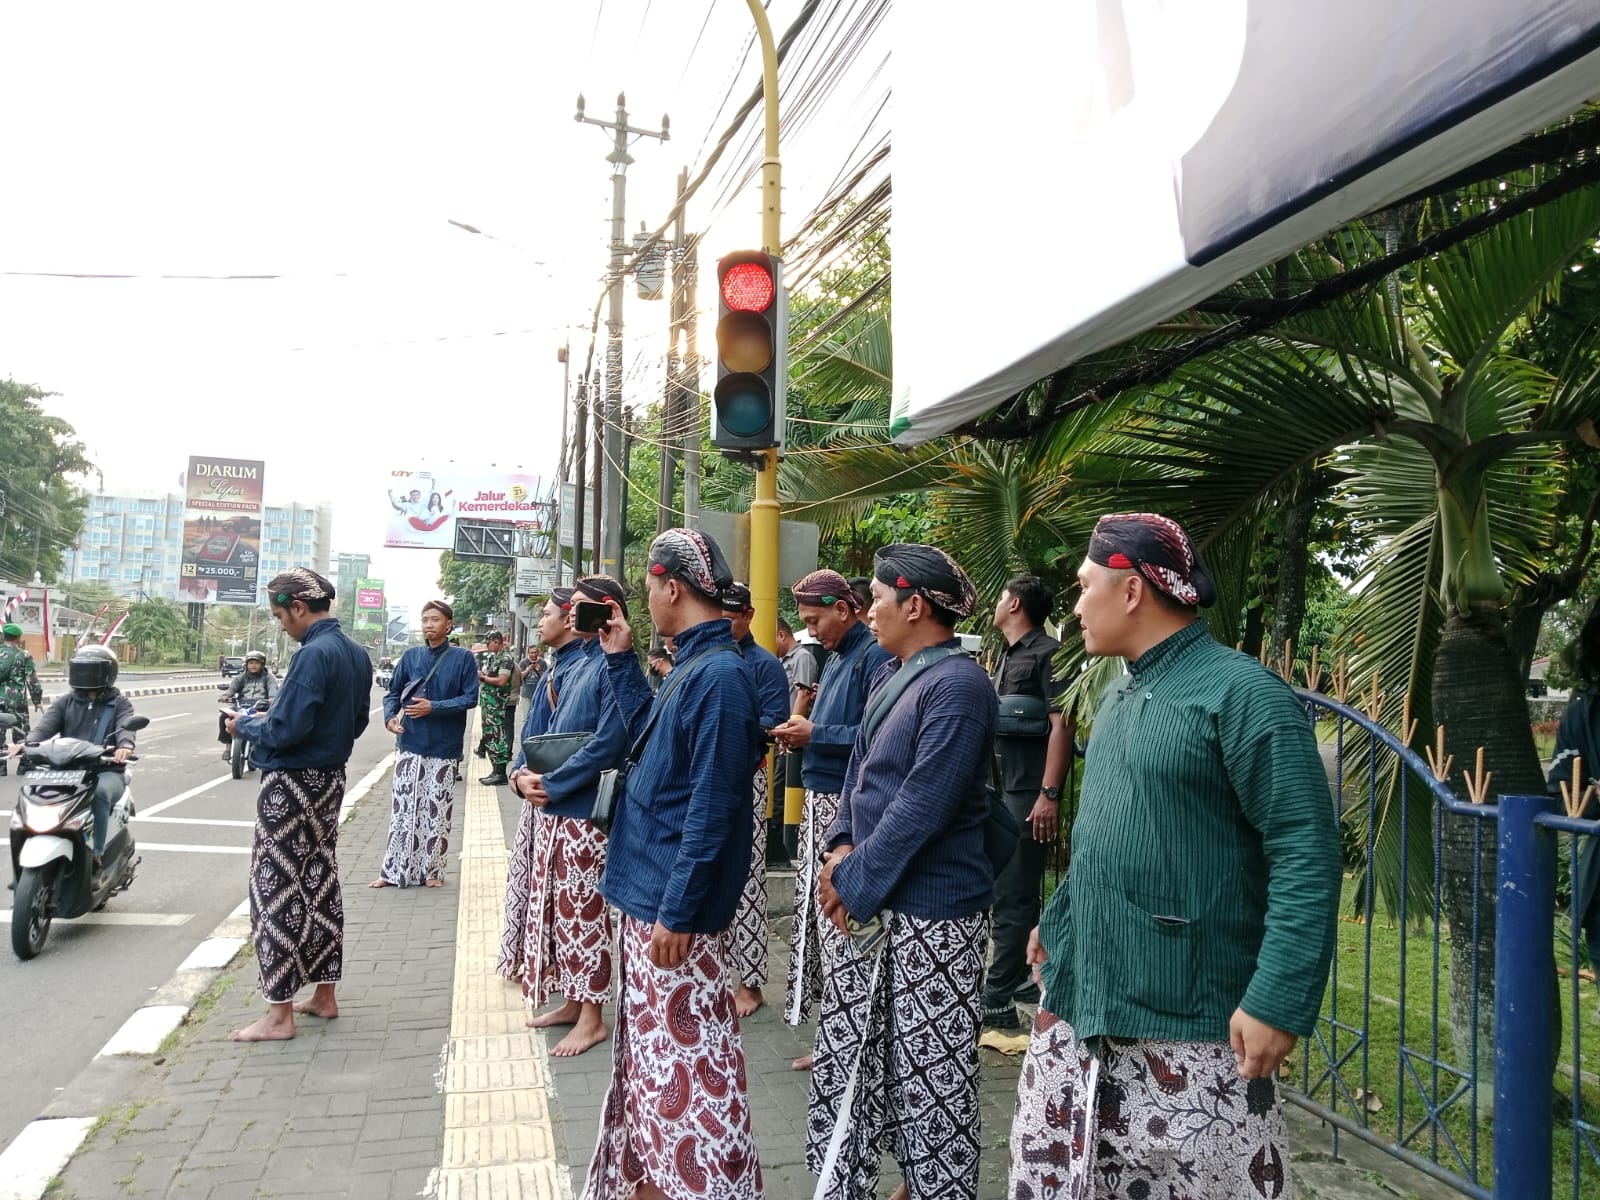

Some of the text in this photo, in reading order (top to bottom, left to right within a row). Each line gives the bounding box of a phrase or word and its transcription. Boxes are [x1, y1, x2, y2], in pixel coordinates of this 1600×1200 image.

[195, 463, 257, 479] DJARUM
[474, 490, 506, 501] Jalur
[184, 564, 194, 573] 12
